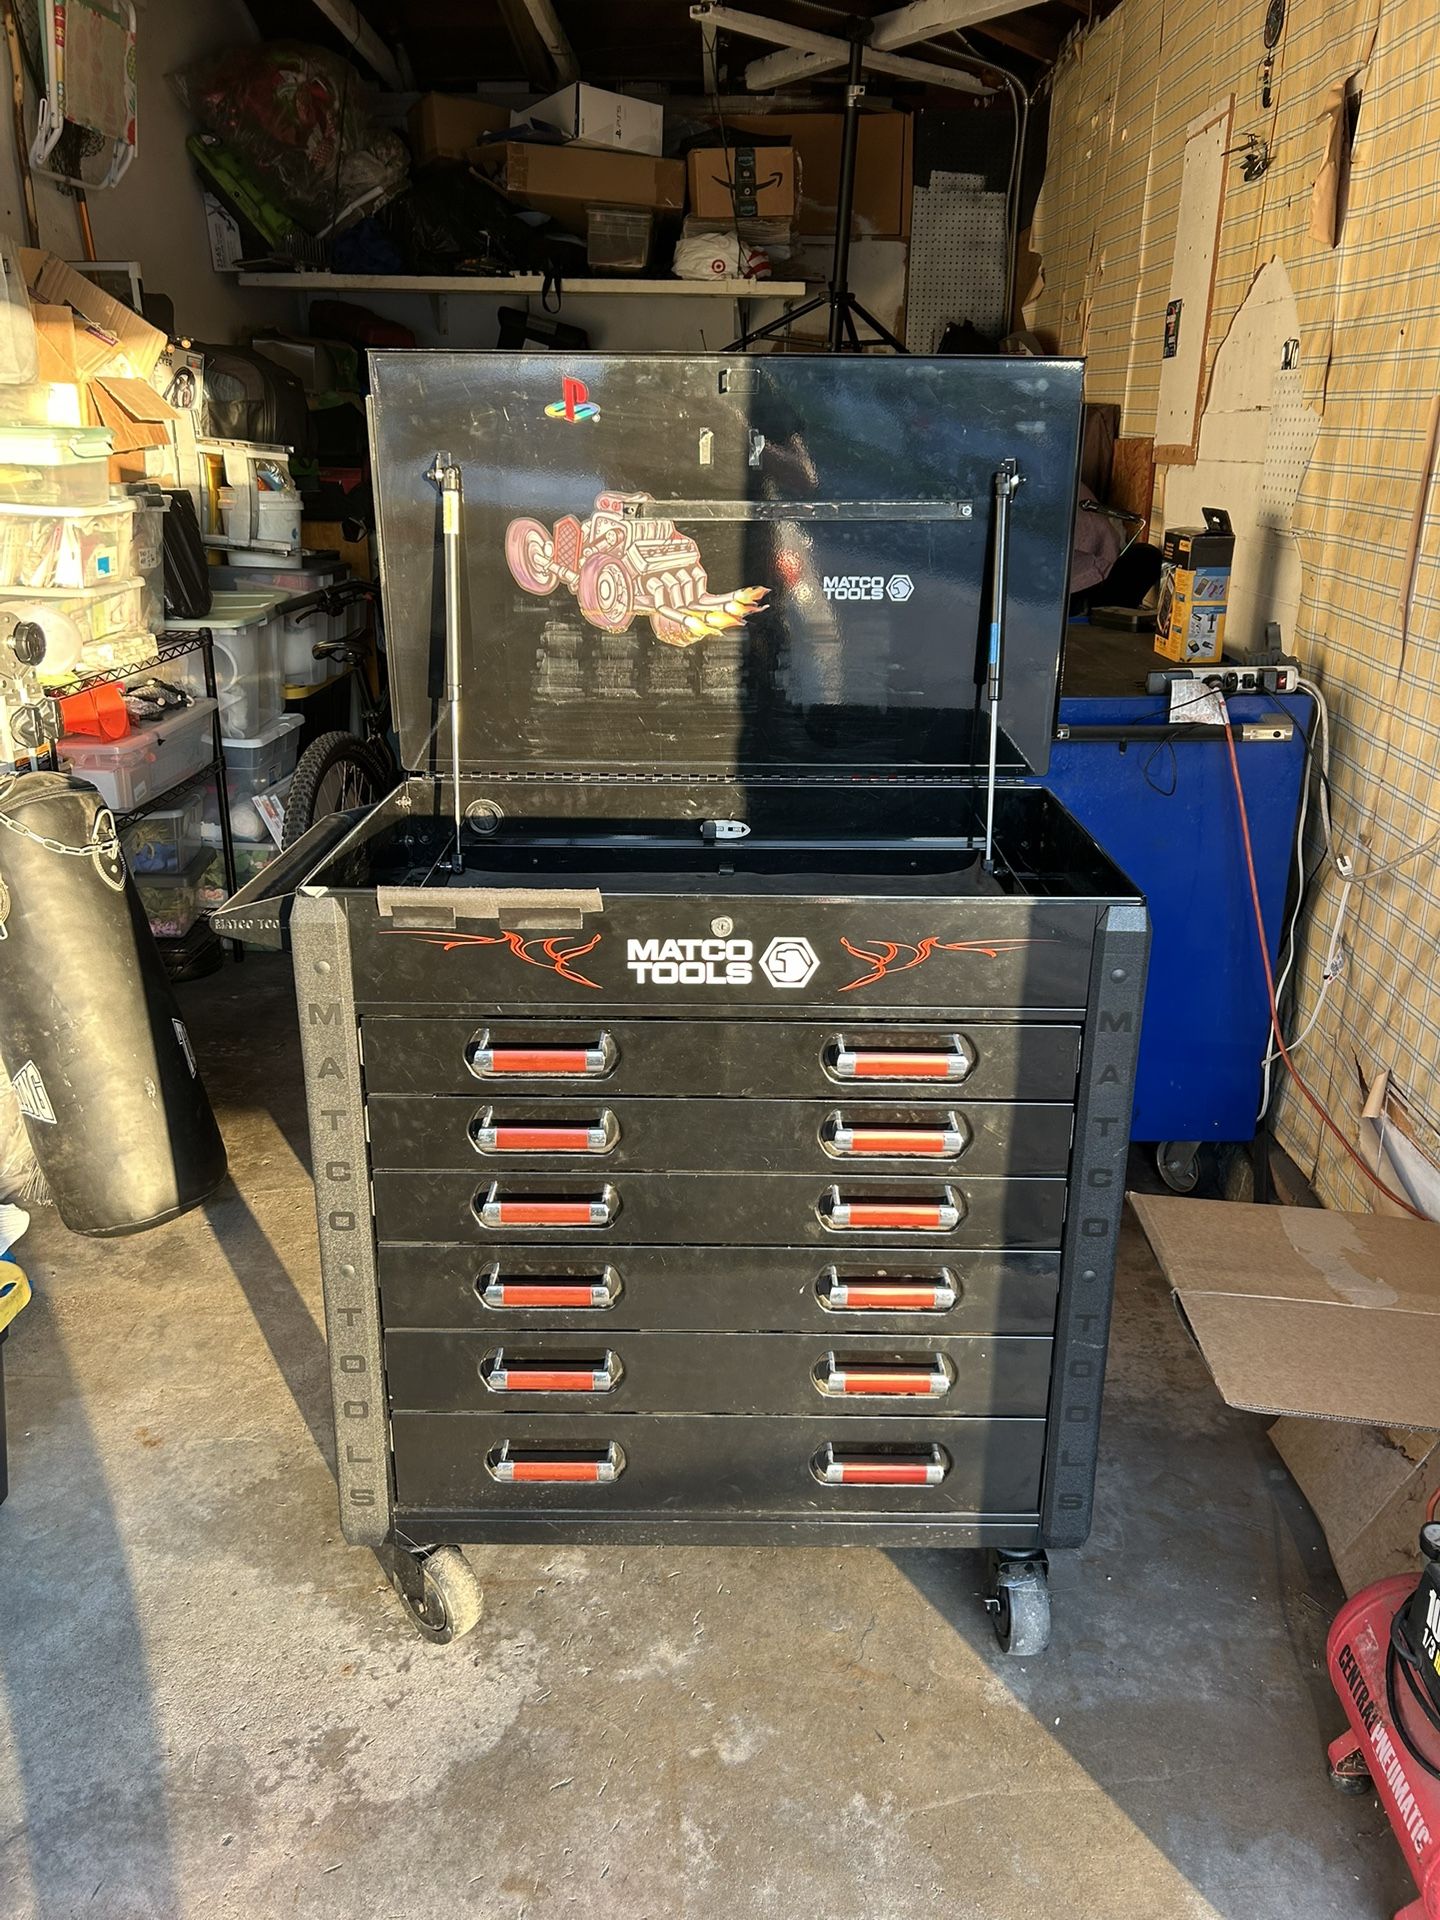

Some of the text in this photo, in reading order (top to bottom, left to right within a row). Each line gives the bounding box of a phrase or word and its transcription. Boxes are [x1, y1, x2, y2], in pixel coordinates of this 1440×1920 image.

[823, 576, 884, 588] MATCO
[823, 588, 884, 600] TOOLS
[257, 919, 281, 930] TOO
[627, 939, 753, 961] MATCO
[627, 962, 753, 985] TOOLS
[308, 1003, 375, 1507] MATCO TOOLS
[1058, 1010, 1132, 1510] MATCO TOOLS
[1339, 1643, 1380, 1736] CENTRAL
[1370, 1720, 1432, 1855] PNEUMATIC
